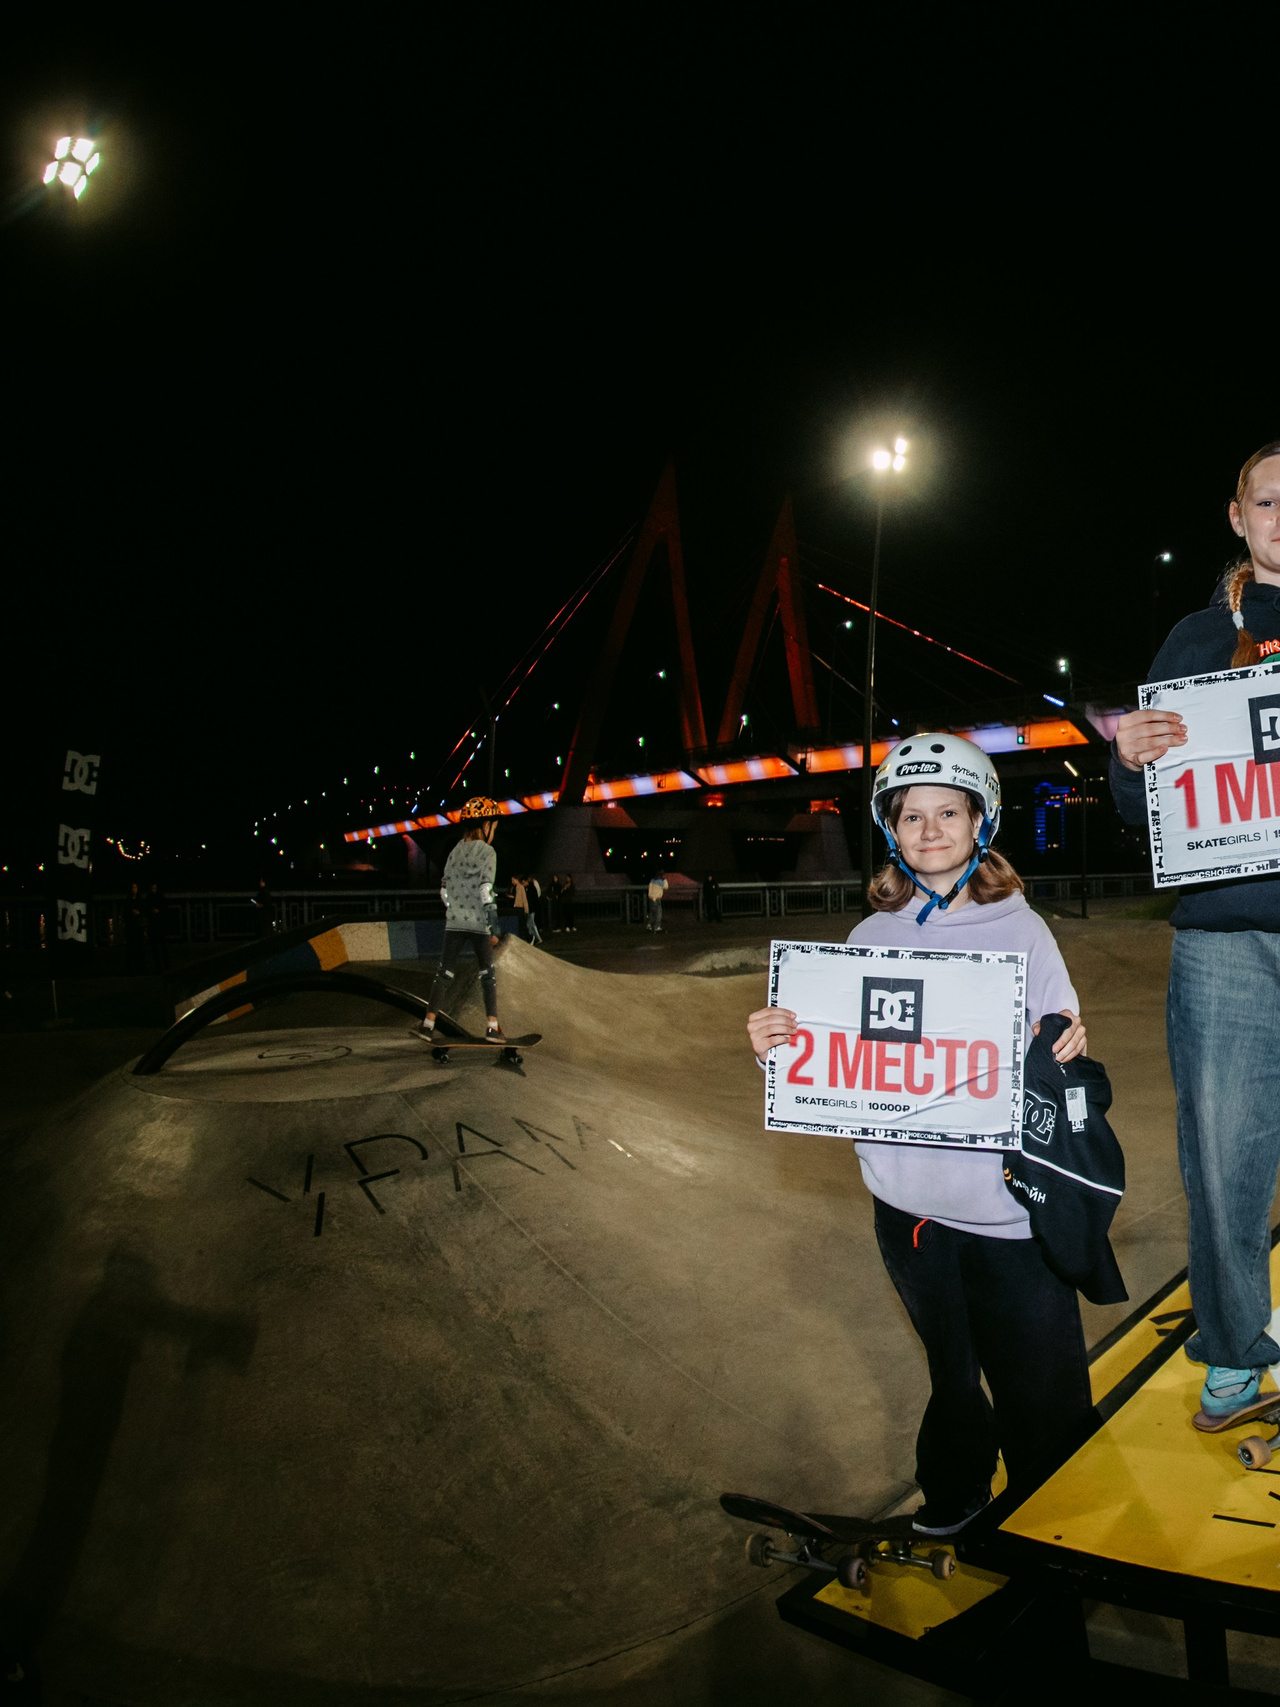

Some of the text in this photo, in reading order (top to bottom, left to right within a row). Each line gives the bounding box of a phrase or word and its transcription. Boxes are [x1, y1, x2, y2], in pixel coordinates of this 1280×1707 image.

[900, 762, 937, 776] Pro-tec
[1174, 769, 1199, 830] 1
[1187, 832, 1261, 851] SKATEGIRLS
[787, 1029, 999, 1100] 2 МЕСТО
[795, 1095, 858, 1109] SKATEGIRLS
